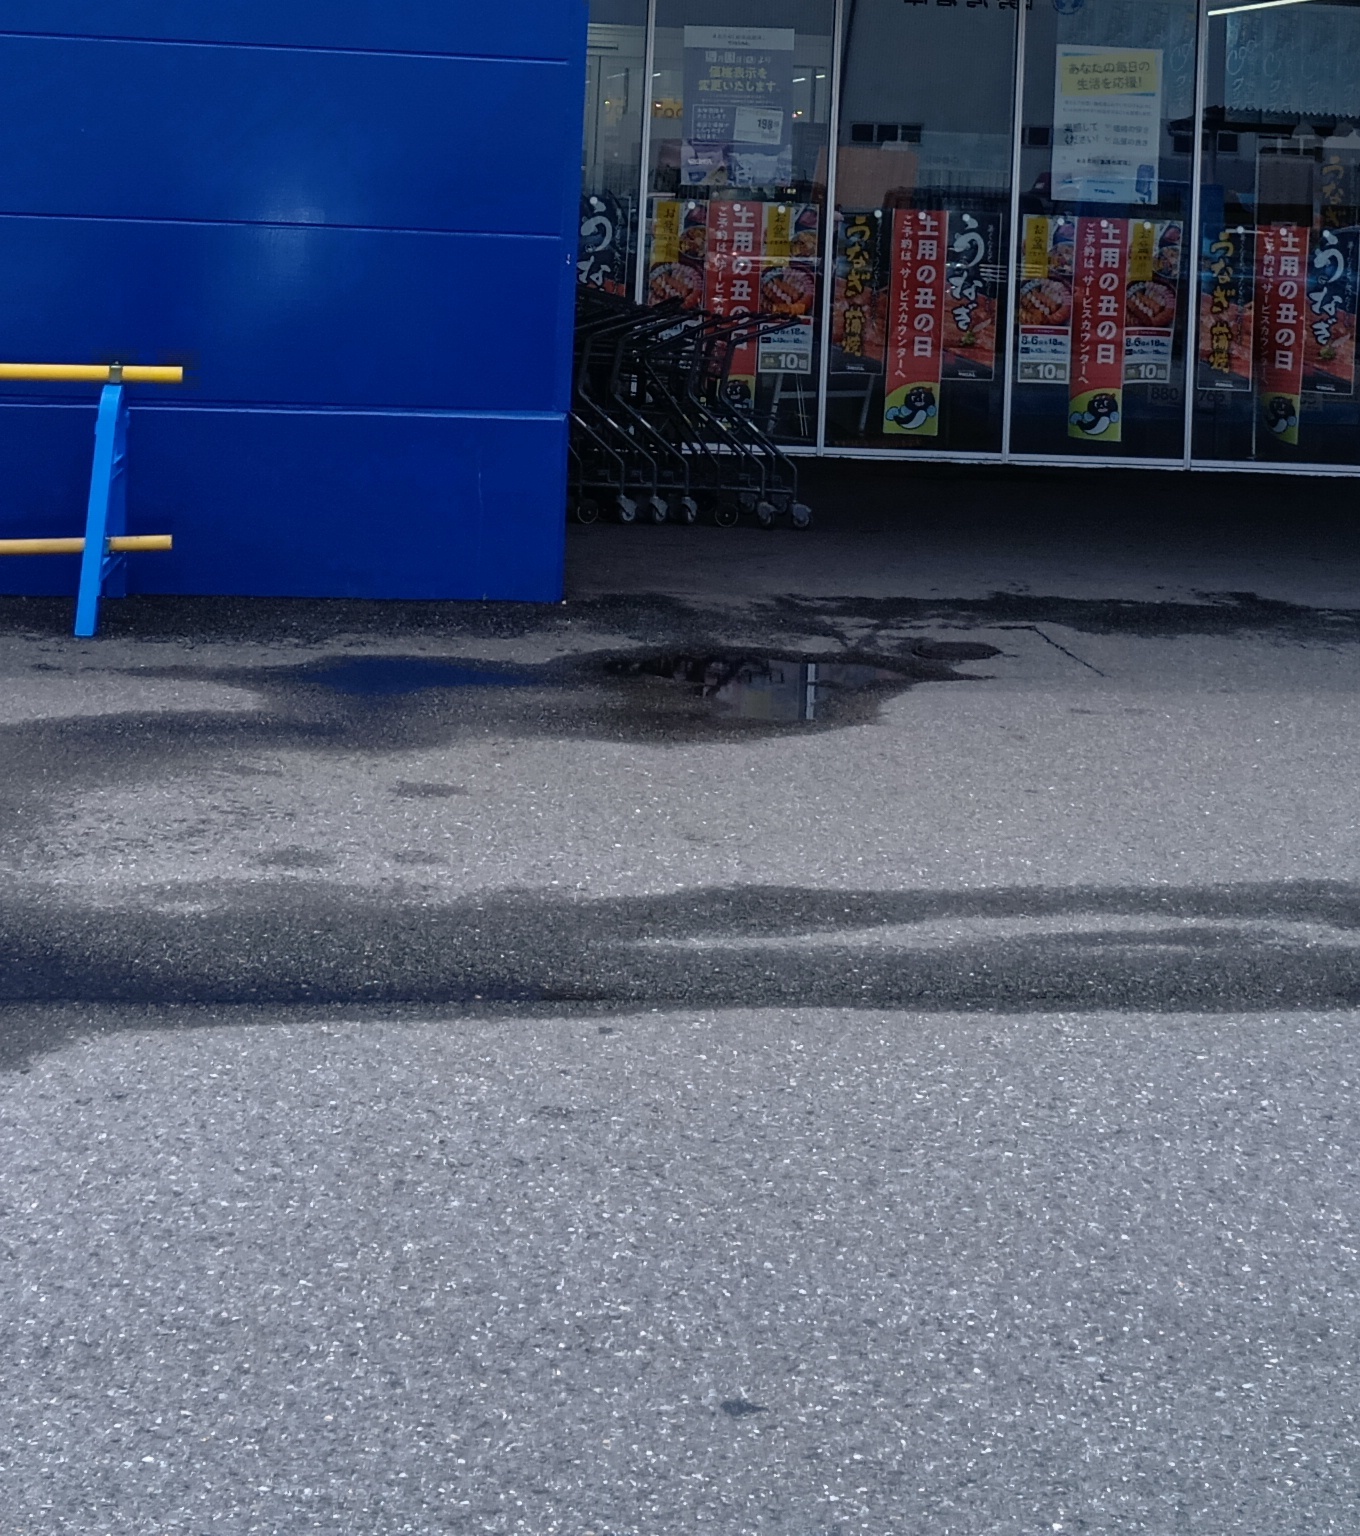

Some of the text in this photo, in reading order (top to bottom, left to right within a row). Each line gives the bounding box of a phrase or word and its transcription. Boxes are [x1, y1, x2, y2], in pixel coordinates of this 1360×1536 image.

[1068, 60, 1150, 74] あなたの毎日の
[895, 215, 912, 379] ご予約は、サービスカウンターへ
[913, 215, 939, 358] 土用の丑の日
[948, 216, 985, 332] うなぎ
[1078, 222, 1097, 384] ご予約は、サービスカウンターへ
[1096, 222, 1122, 365] 土用の丑の日
[1275, 232, 1301, 371] 土用の丑の日
[1308, 230, 1345, 345] うなぎ
